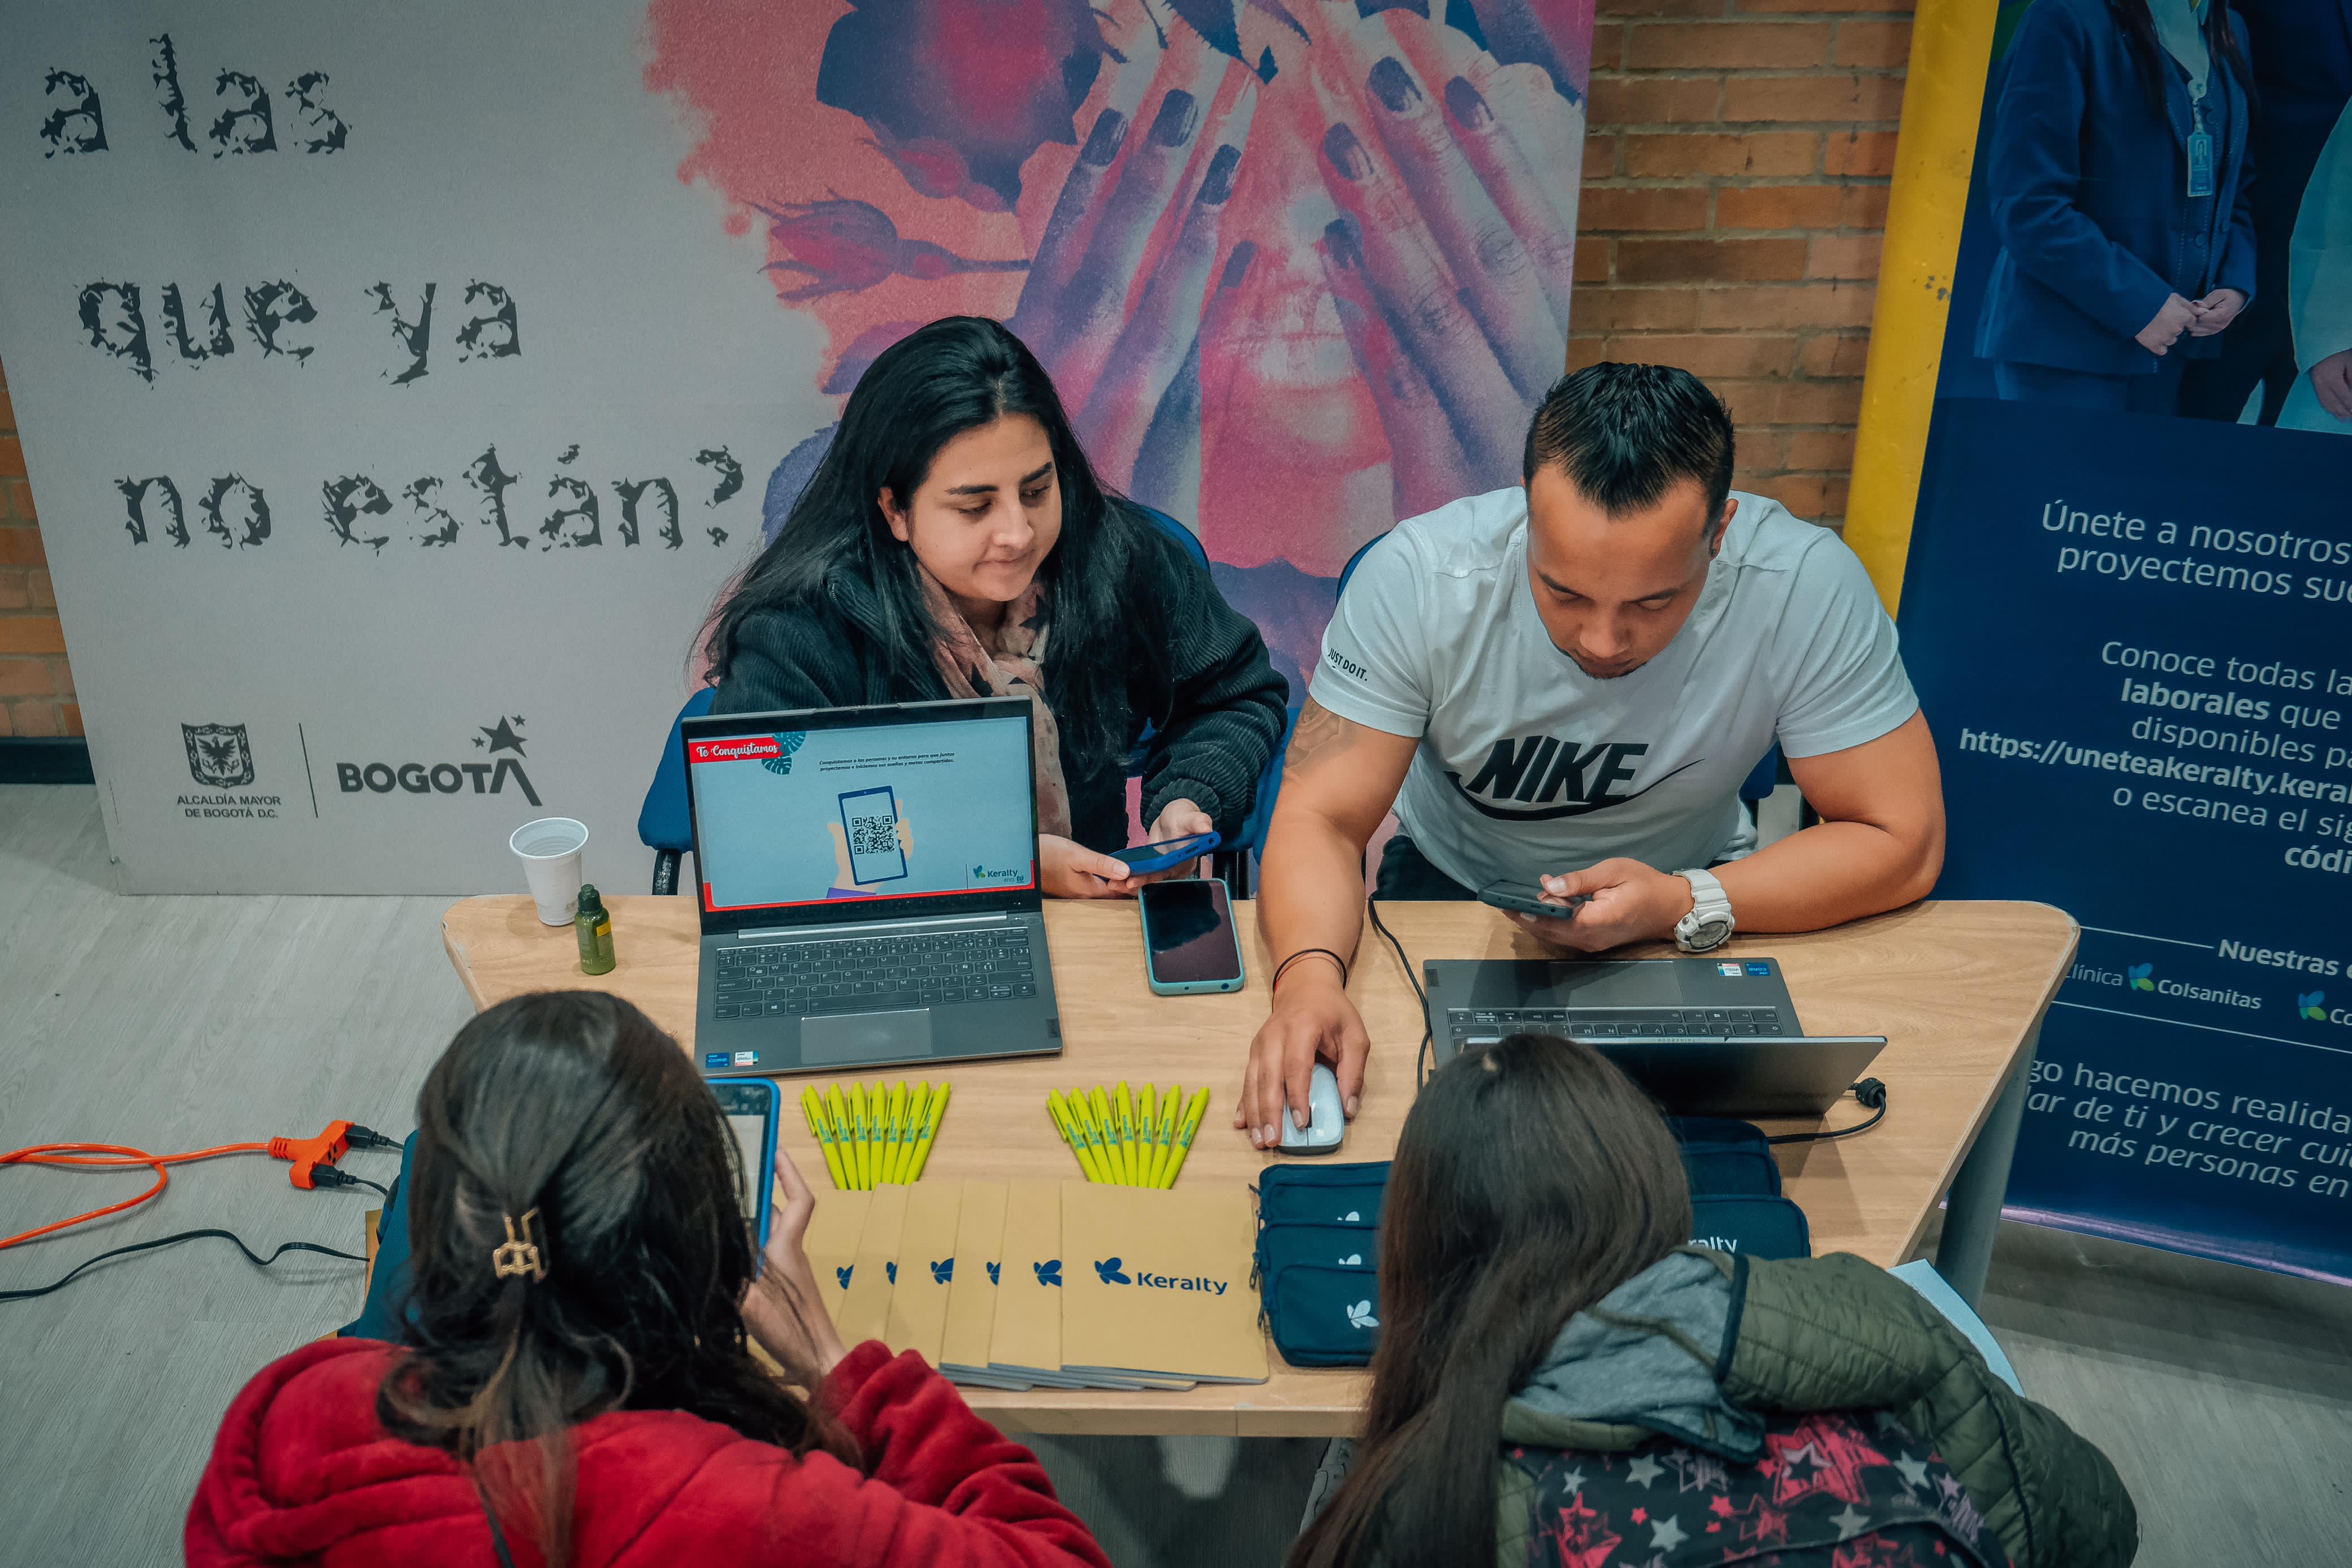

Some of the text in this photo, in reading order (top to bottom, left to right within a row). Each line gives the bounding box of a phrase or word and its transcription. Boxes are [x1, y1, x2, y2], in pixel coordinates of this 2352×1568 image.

[40, 33, 352, 159] a las
[72, 268, 521, 389] que ya
[114, 443, 745, 557] no están?
[2042, 499, 2351, 565] Únete a nosotros
[2057, 546, 2352, 603] proyectemos su
[1328, 647, 1368, 682] JUST DO IT.
[2102, 641, 2215, 677] Conoce
[2226, 656, 2316, 690] todas
[2121, 678, 2341, 730] laborales que
[696, 742, 779, 759] Te Conquistamos
[2131, 716, 2316, 763] disponibles
[1464, 735, 1649, 804] NIKE
[177, 794, 282, 805] ALCALDÍA MAYOR
[185, 807, 278, 818] DE BOGOTÁ D.C.
[2113, 787, 2132, 807] o
[2142, 790, 2268, 826] escanea
[2278, 808, 2308, 832] el
[987, 869, 1018, 878] Keralty
[2218, 939, 2340, 977] Nuestras
[2065, 964, 2263, 1010] línica Colsanitas
[2074, 1063, 2221, 1110] hacemos
[2231, 1094, 2351, 1134] realida
[2026, 1085, 2352, 1168] ar de ti y crecer cui
[2068, 1129, 2350, 1198] más personas en
[1137, 1272, 1229, 1296] Keralty
